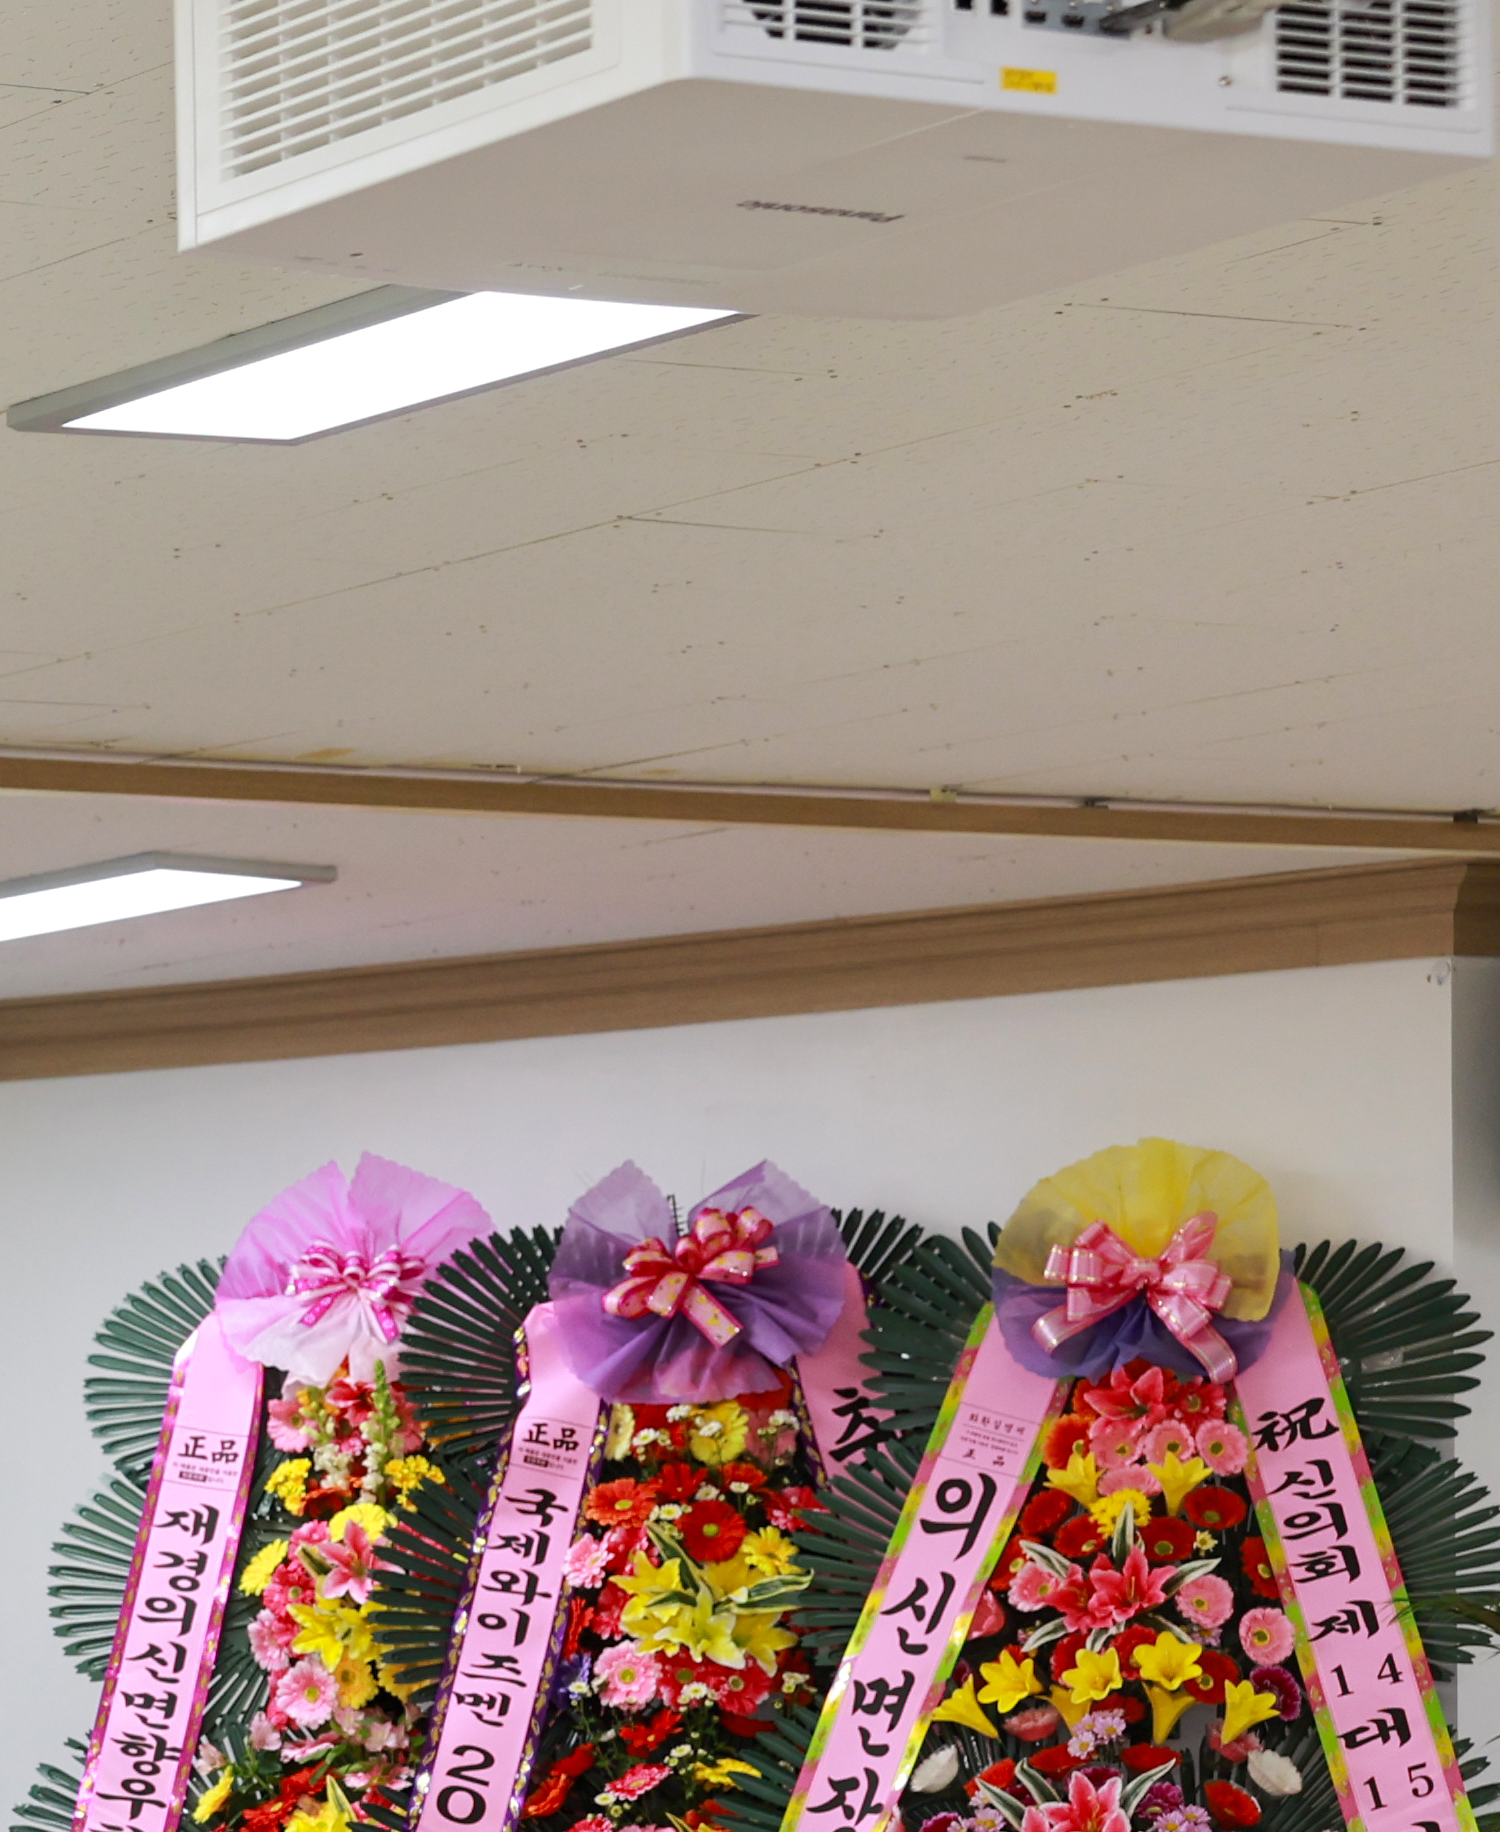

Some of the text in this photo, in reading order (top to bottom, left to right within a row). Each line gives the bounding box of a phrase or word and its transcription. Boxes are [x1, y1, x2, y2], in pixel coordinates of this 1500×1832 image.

[522, 1422, 580, 1452] 正品
[1253, 1397, 1340, 1453] 祝
[176, 1435, 240, 1465] 正品
